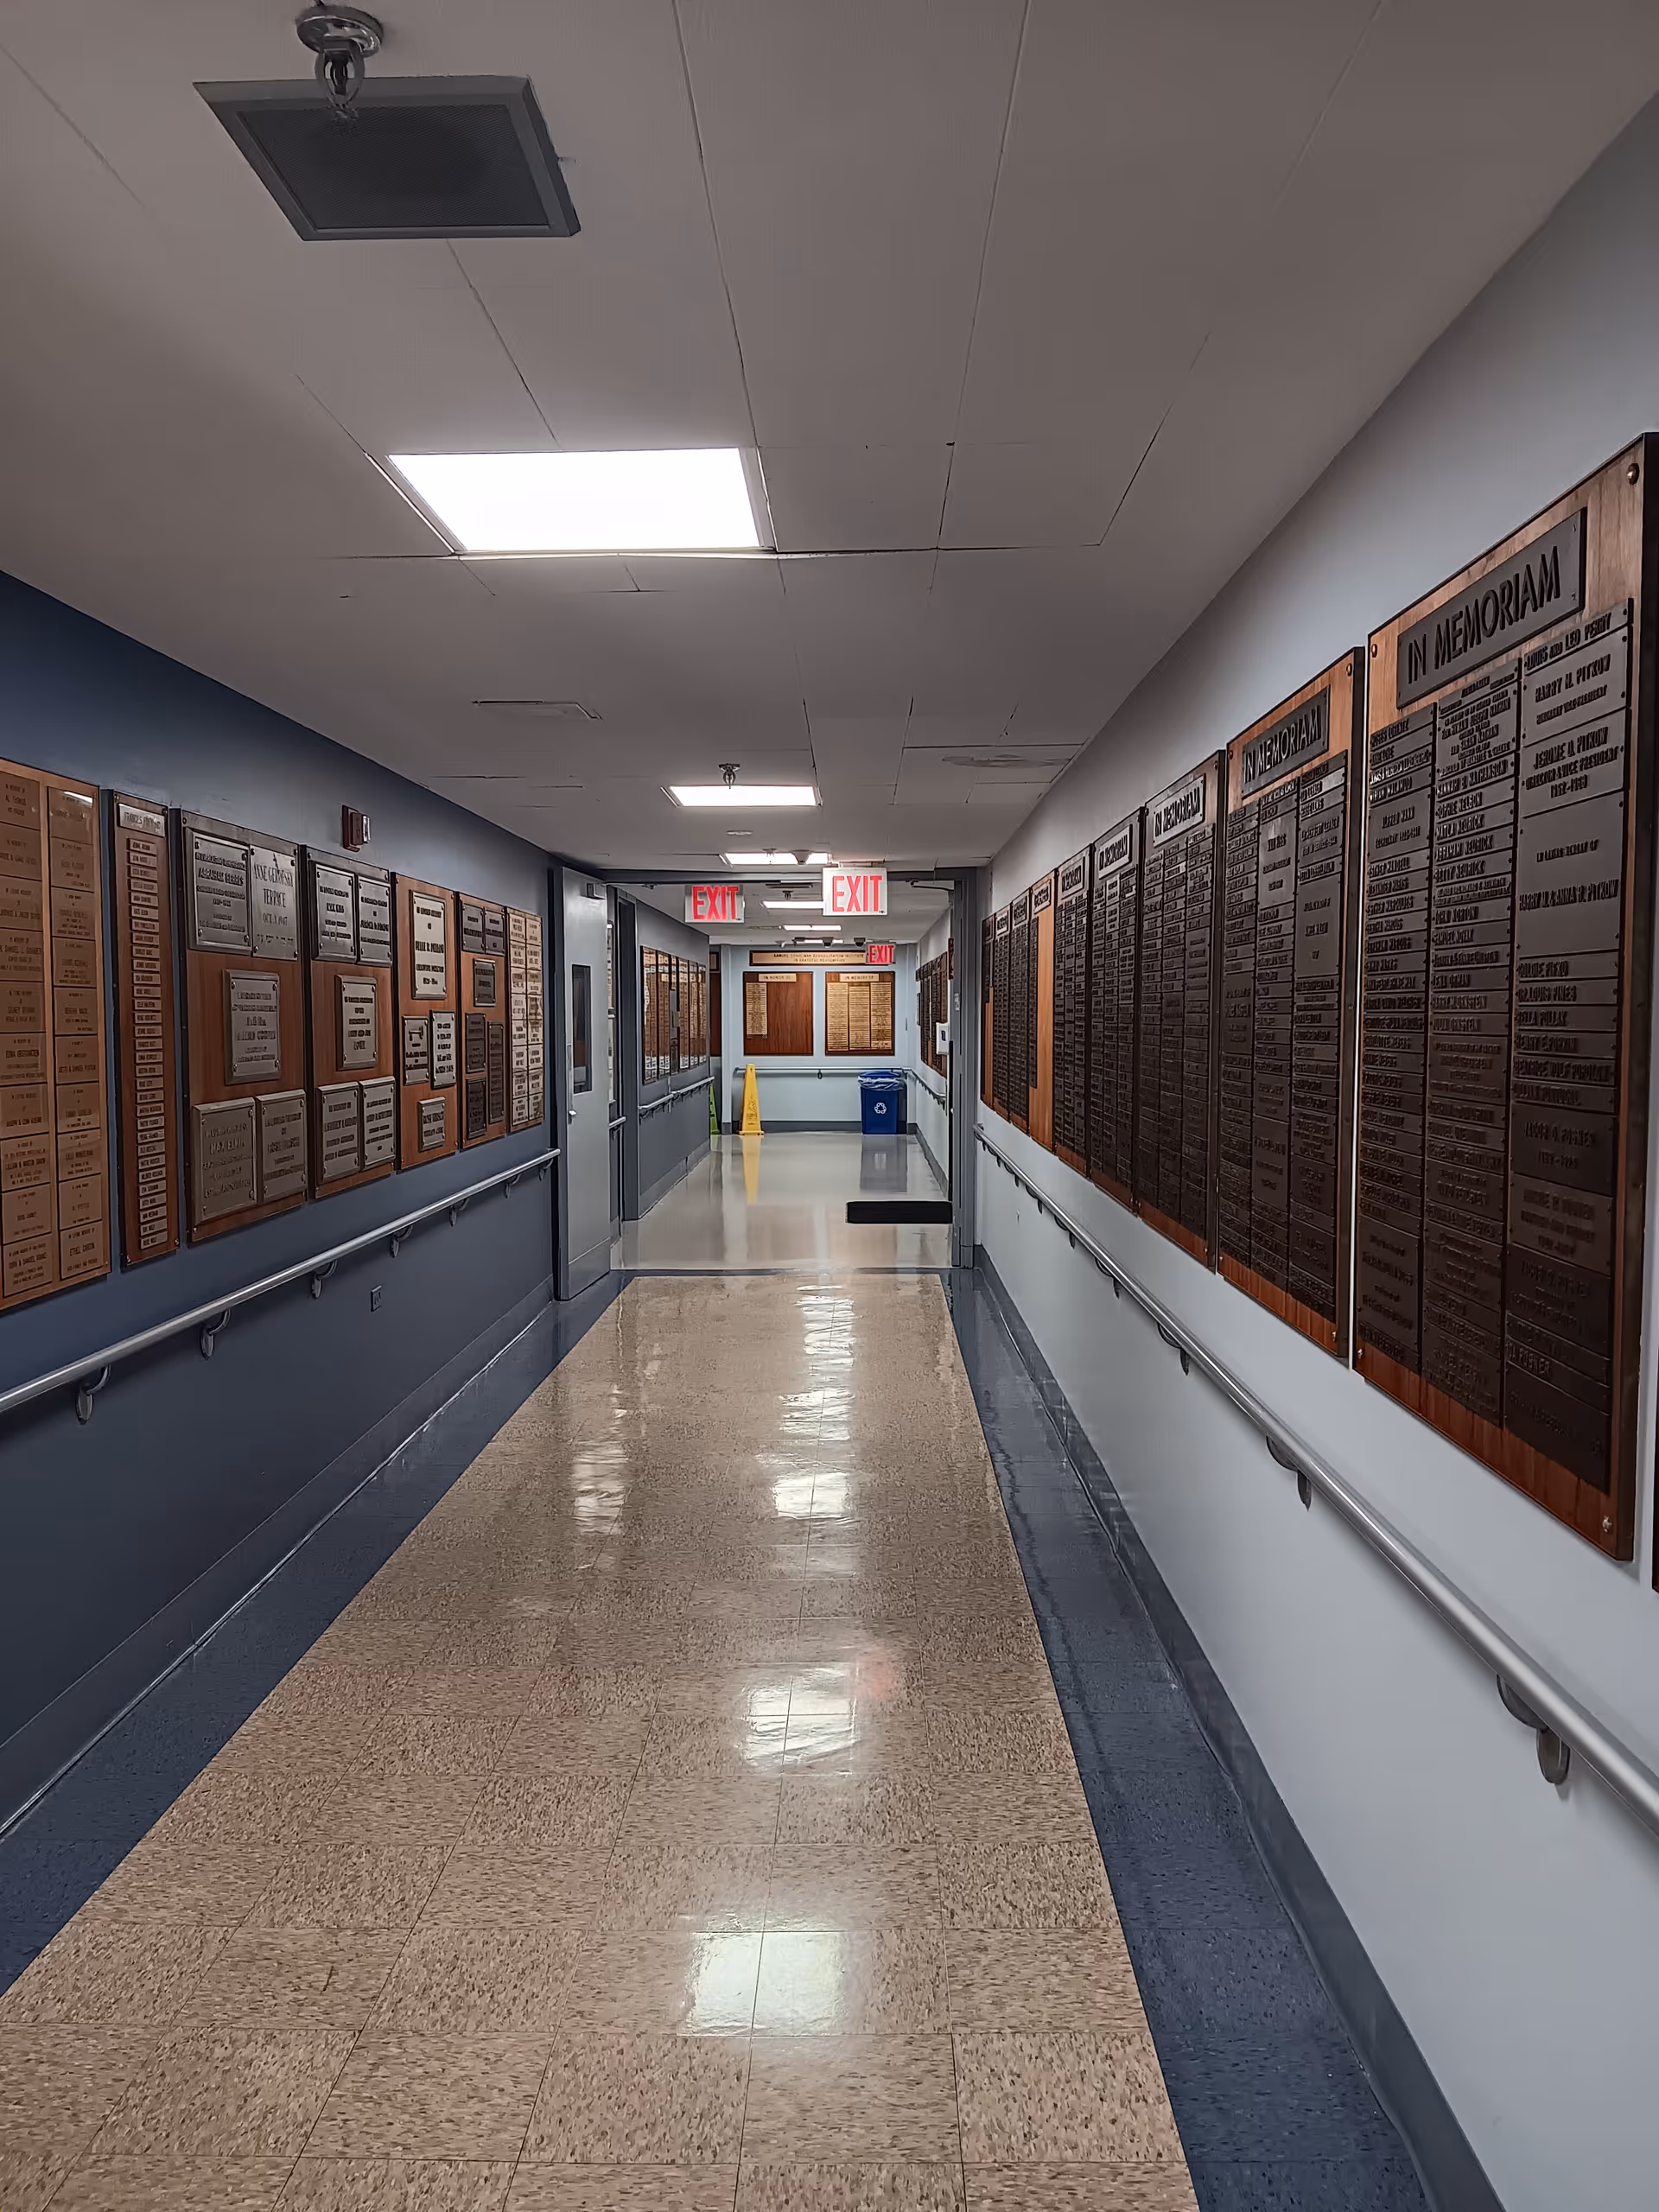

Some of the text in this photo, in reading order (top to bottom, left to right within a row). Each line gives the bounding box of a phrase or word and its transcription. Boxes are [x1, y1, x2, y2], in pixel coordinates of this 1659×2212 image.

[1408, 545, 1560, 684] IN MEMORIAM
[1526, 645, 1548, 671] LOUIS
[1565, 627, 1580, 652] LEO
[1584, 612, 1611, 643] PERRY
[1535, 675, 1562, 704] HARRY
[1575, 652, 1611, 686] PITKOW
[1243, 704, 1321, 784] IN MEMORIAM
[1533, 741, 1566, 770] JEROME
[1576, 725, 1608, 755] PITKOW
[1579, 744, 1618, 773] PRESIDENT
[1469, 759, 1508, 787] NATHANSON
[1163, 786, 1201, 834] MEMORIAM
[1458, 791, 1483, 813] NELSON
[1435, 842, 1463, 862] ABRAHAM
[253, 863, 268, 881] ANNE
[263, 888, 286, 908] TERRACE
[692, 886, 740, 920] EXIT
[832, 874, 883, 912] EXIT
[1586, 878, 1619, 901] PITKOW
[868, 945, 895, 963] EXIT
